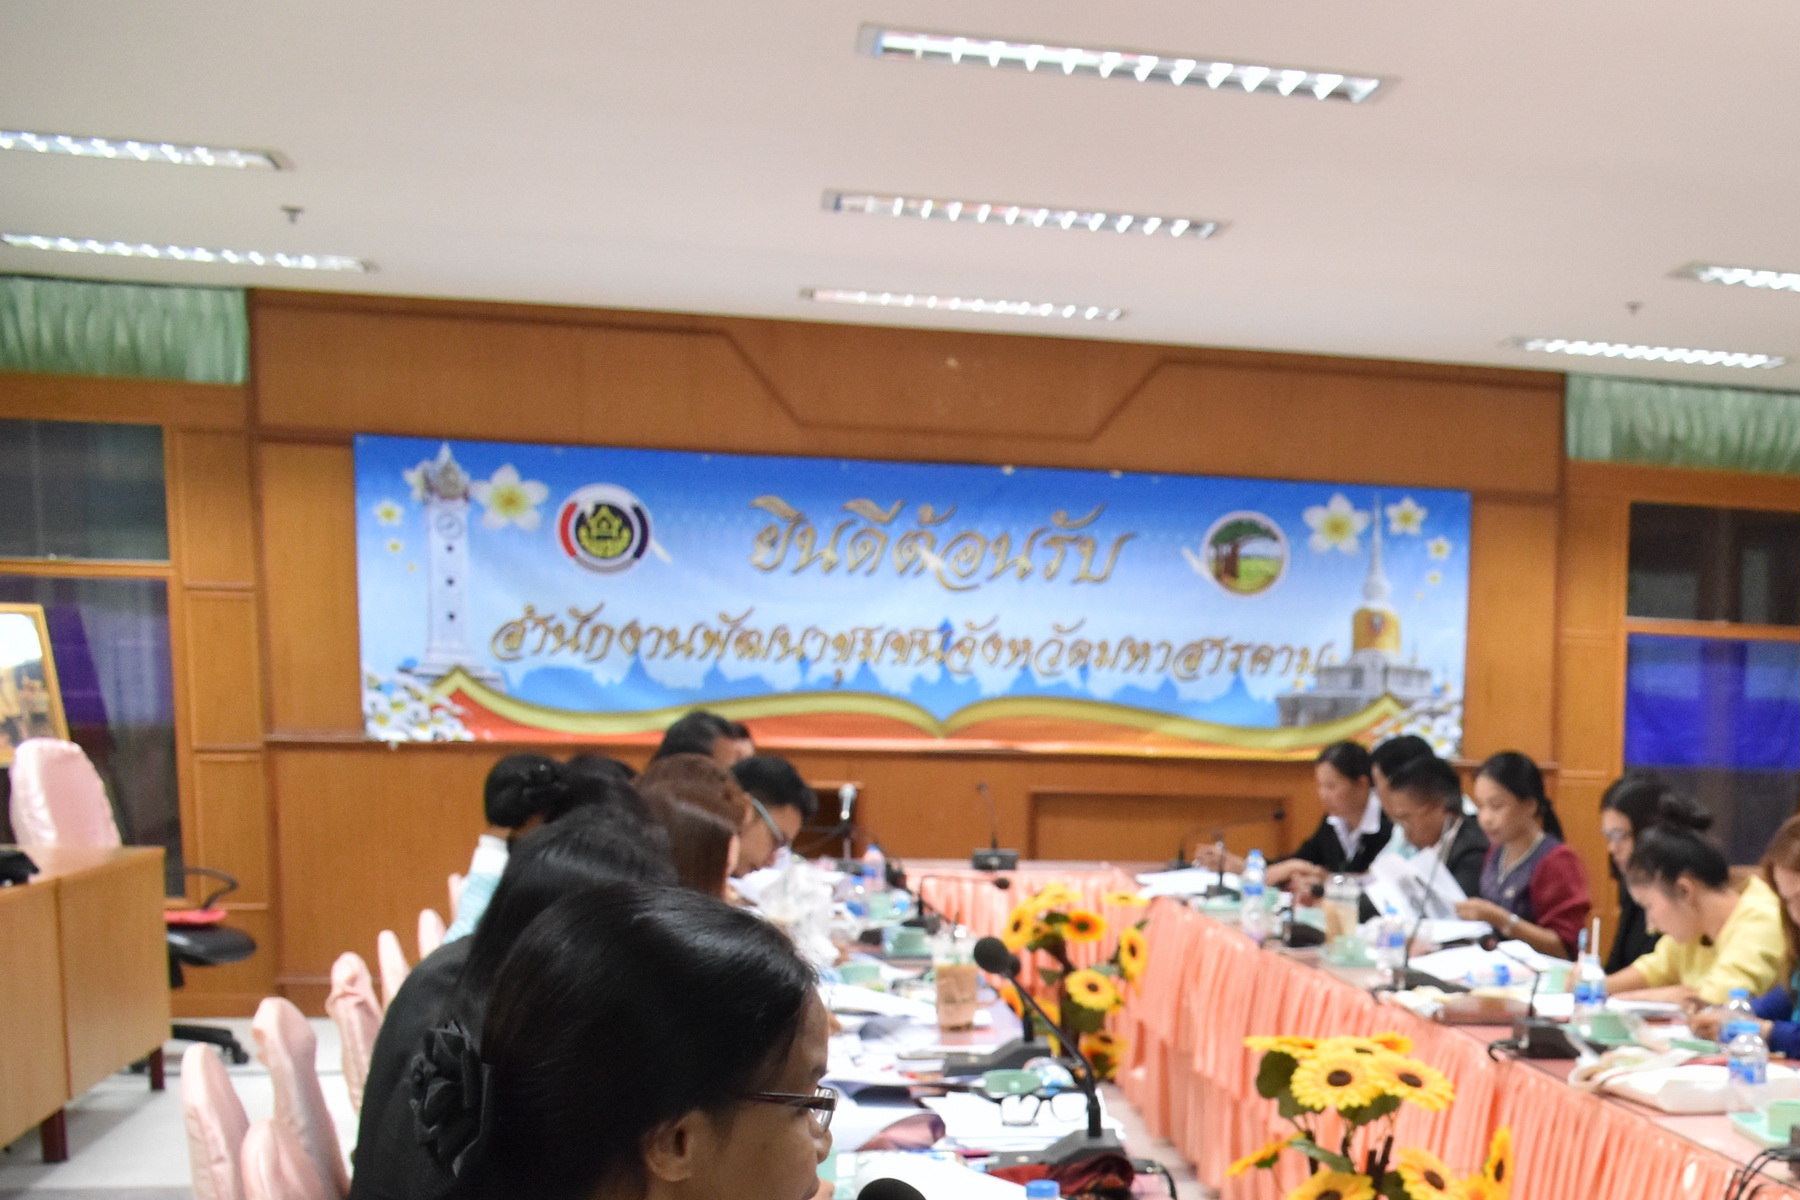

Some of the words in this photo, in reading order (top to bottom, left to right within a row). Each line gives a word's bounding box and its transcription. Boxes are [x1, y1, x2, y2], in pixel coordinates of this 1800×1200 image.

[749, 495, 1138, 592] ยินดีต้อนรับ
